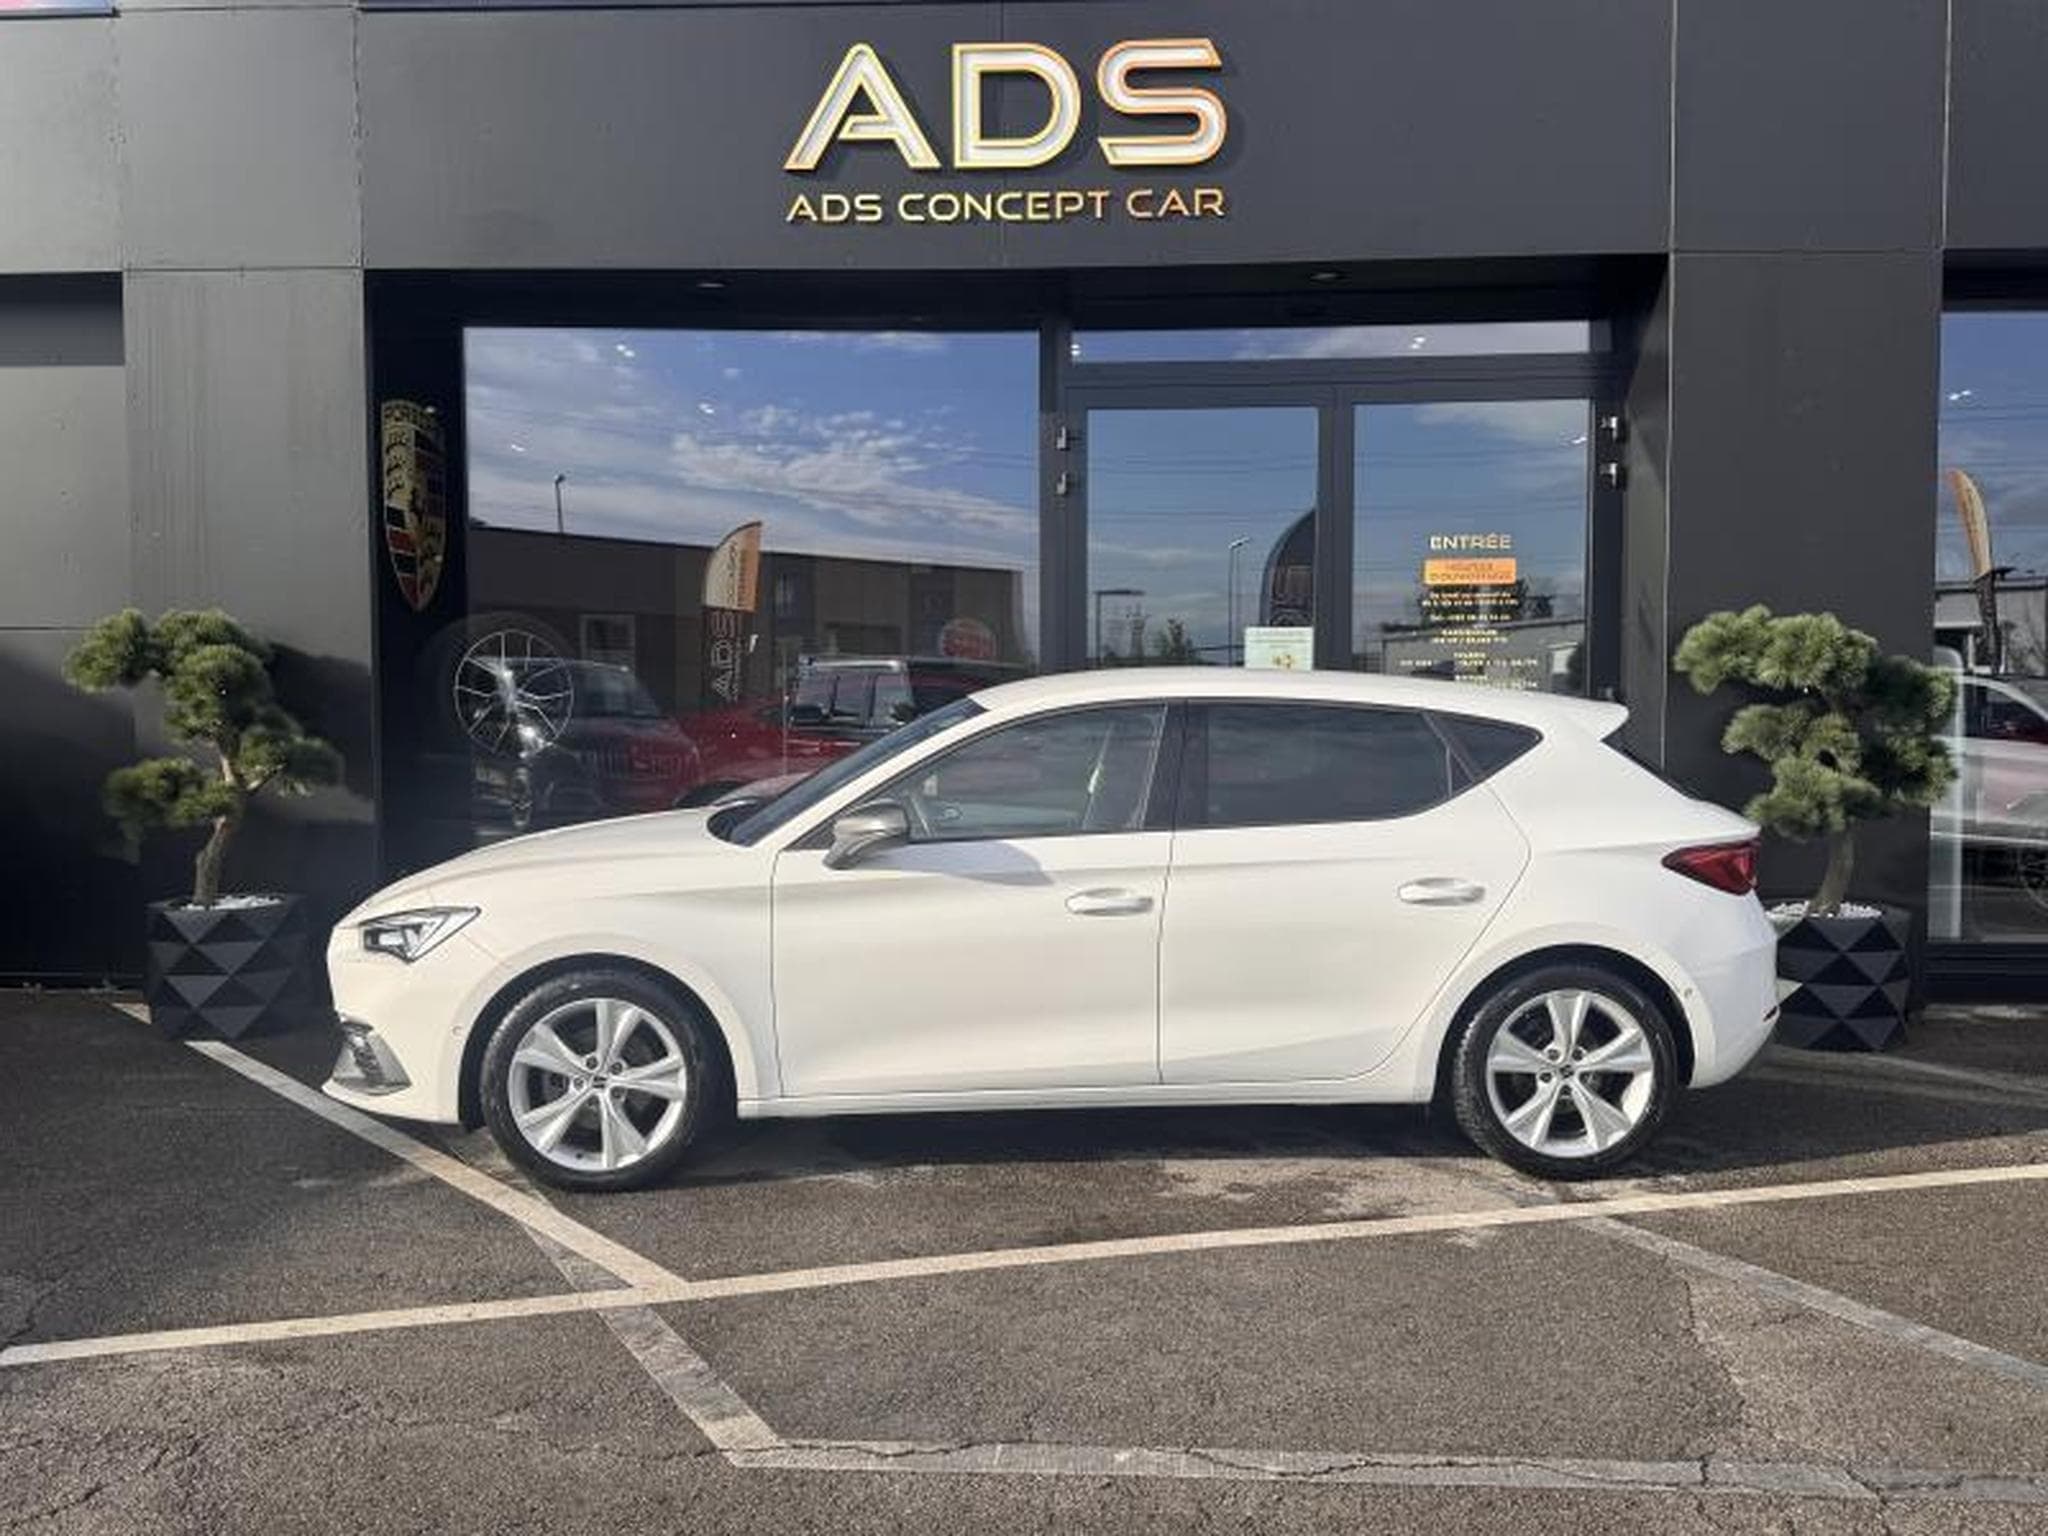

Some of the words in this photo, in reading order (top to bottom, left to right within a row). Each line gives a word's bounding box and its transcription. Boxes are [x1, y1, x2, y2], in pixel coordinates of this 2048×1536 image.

[784, 38, 1227, 170] ADS
[786, 194, 883, 222] ADS
[899, 192, 1109, 222] CONCEPT
[1126, 189, 1225, 217] CAR
